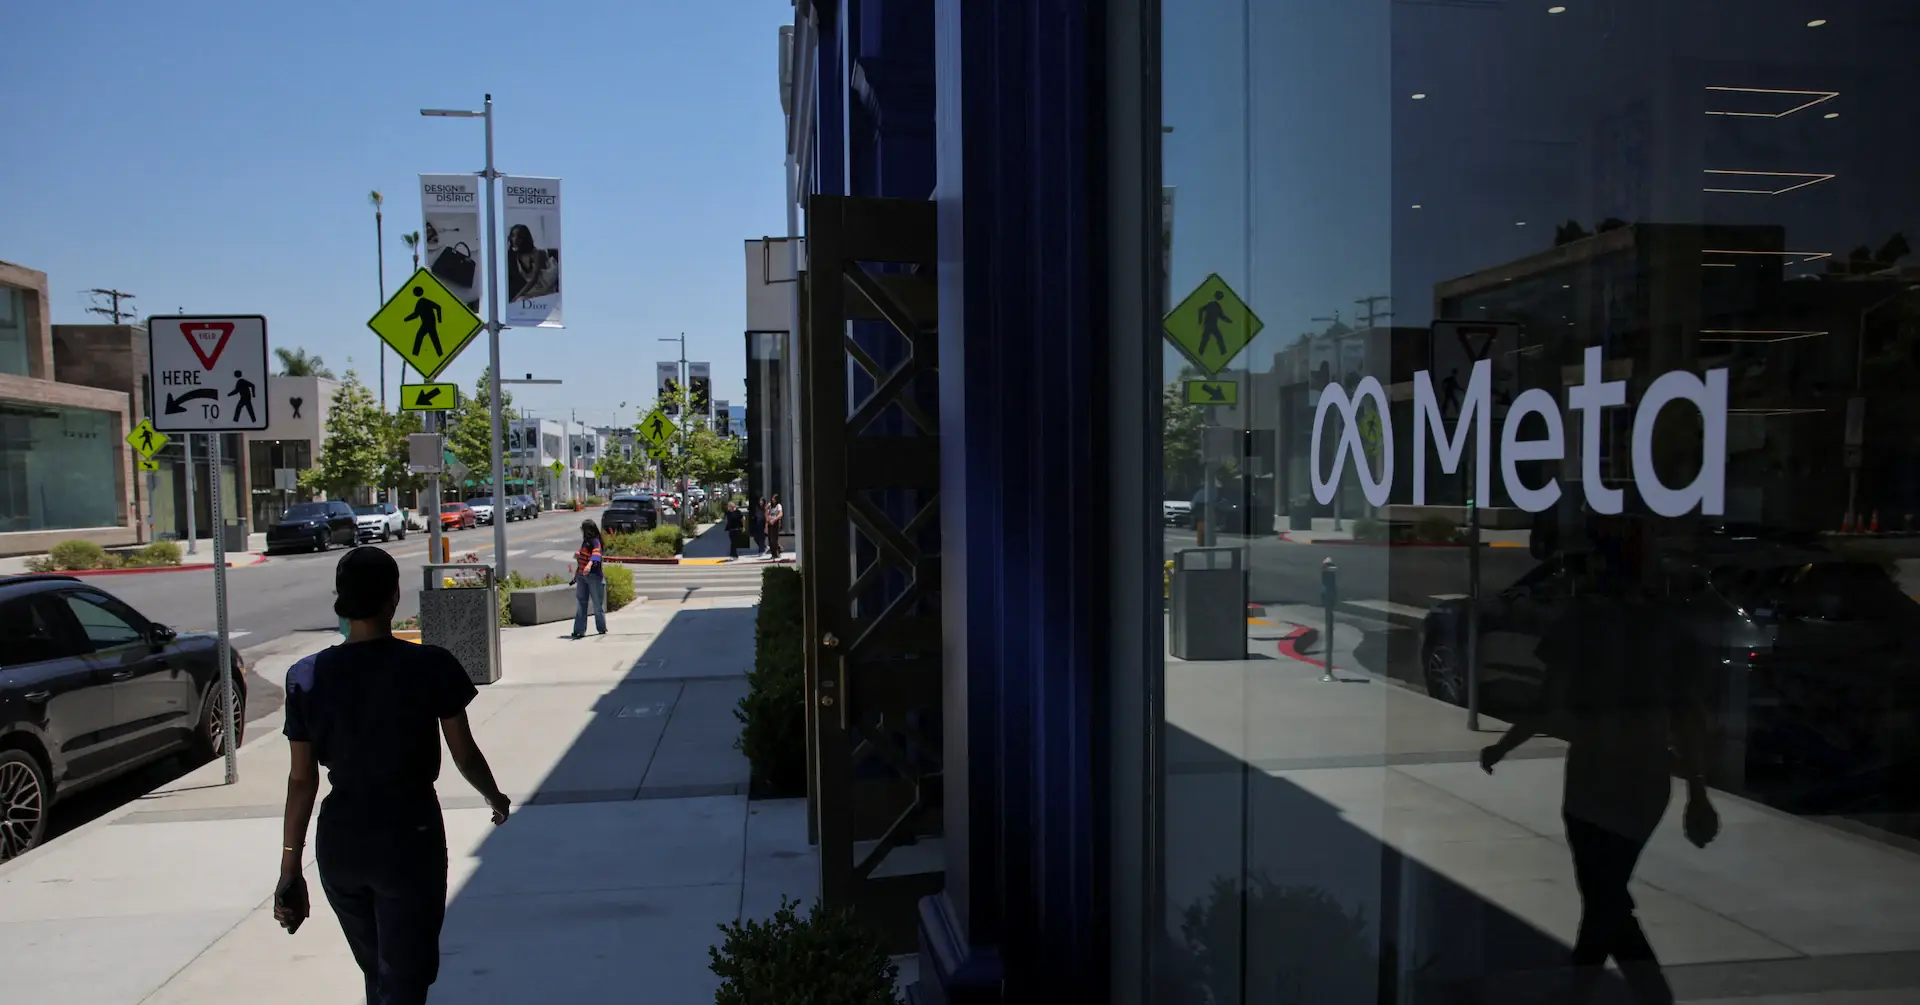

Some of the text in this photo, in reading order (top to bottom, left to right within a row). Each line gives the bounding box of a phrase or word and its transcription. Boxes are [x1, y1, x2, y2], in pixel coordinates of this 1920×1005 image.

[424, 184, 459, 193] DESIGN
[506, 186, 541, 195] DESIGN
[436, 193, 474, 202] DISTRICT
[518, 195, 556, 205] DISTRICT
[522, 299, 548, 310] Dior
[199, 332, 217, 340] YIELD
[162, 370, 202, 385] HERE
[201, 404, 220, 420] TO
[1412, 346, 1729, 518] Meta
